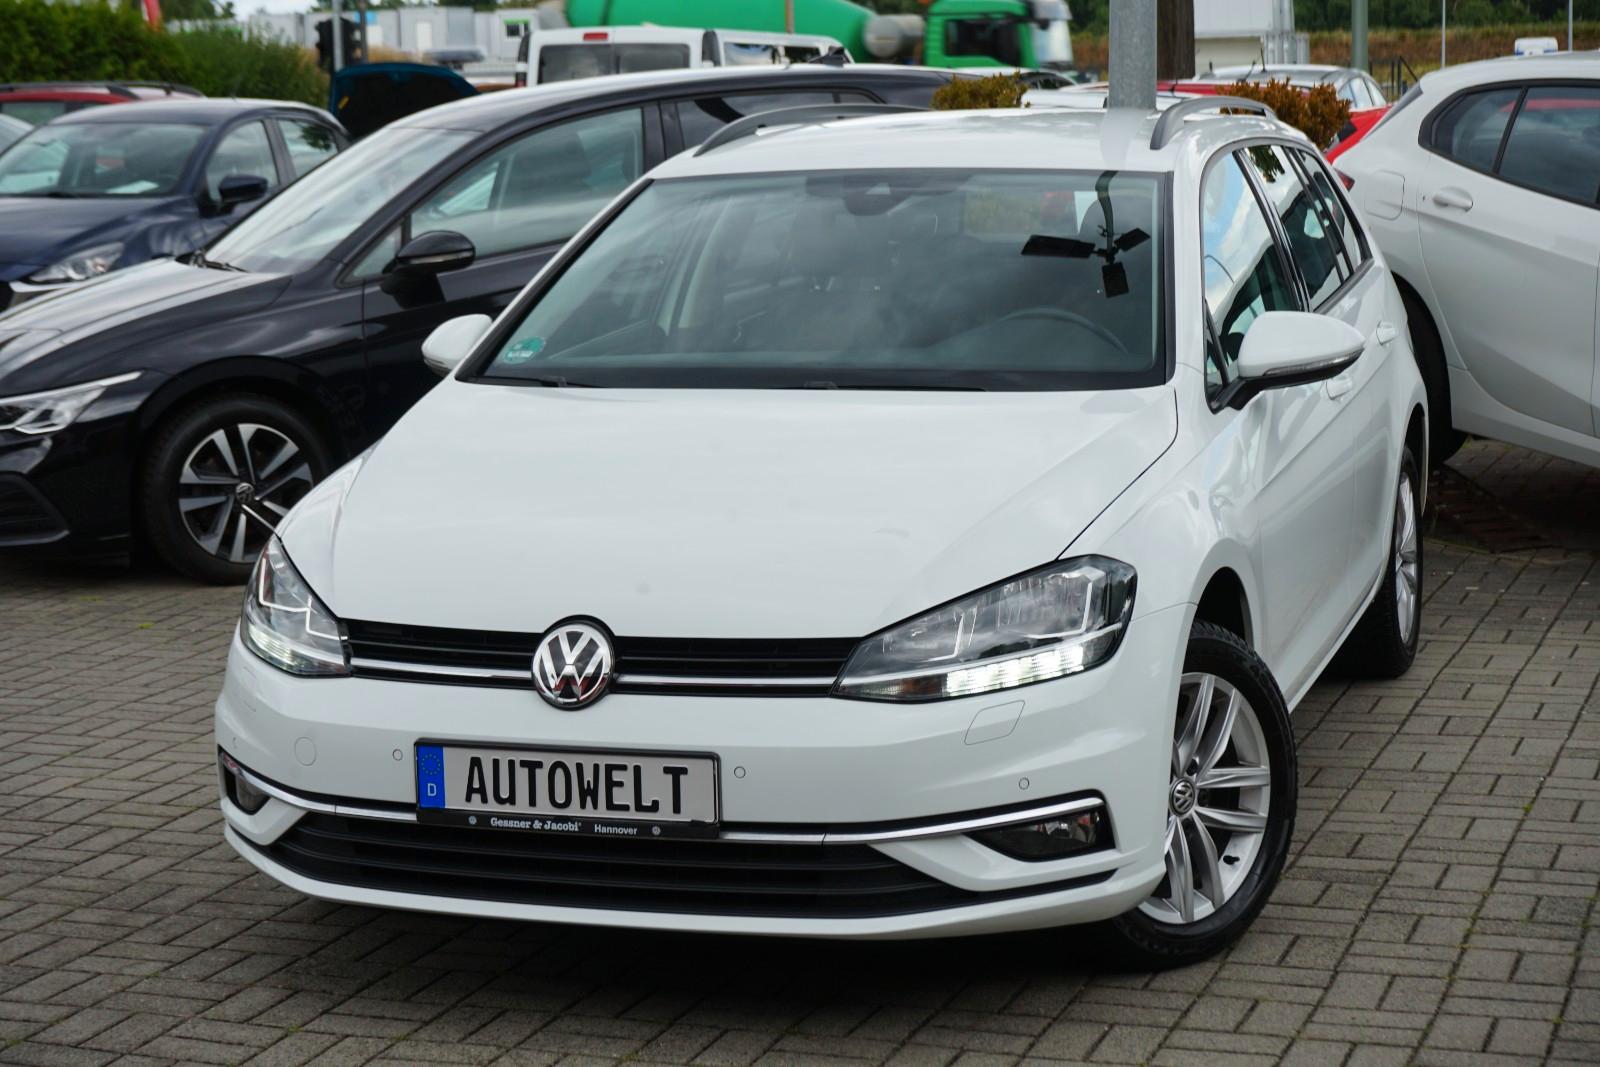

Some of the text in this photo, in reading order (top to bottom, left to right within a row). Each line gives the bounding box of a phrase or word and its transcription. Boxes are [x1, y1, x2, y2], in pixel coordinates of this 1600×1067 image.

[533, 624, 611, 702] VW
[427, 782, 437, 796] D
[465, 756, 689, 814] AUTOWELT
[490, 817, 531, 829] Gessner
[533, 819, 543, 830] &
[594, 823, 638, 836] Hannover
